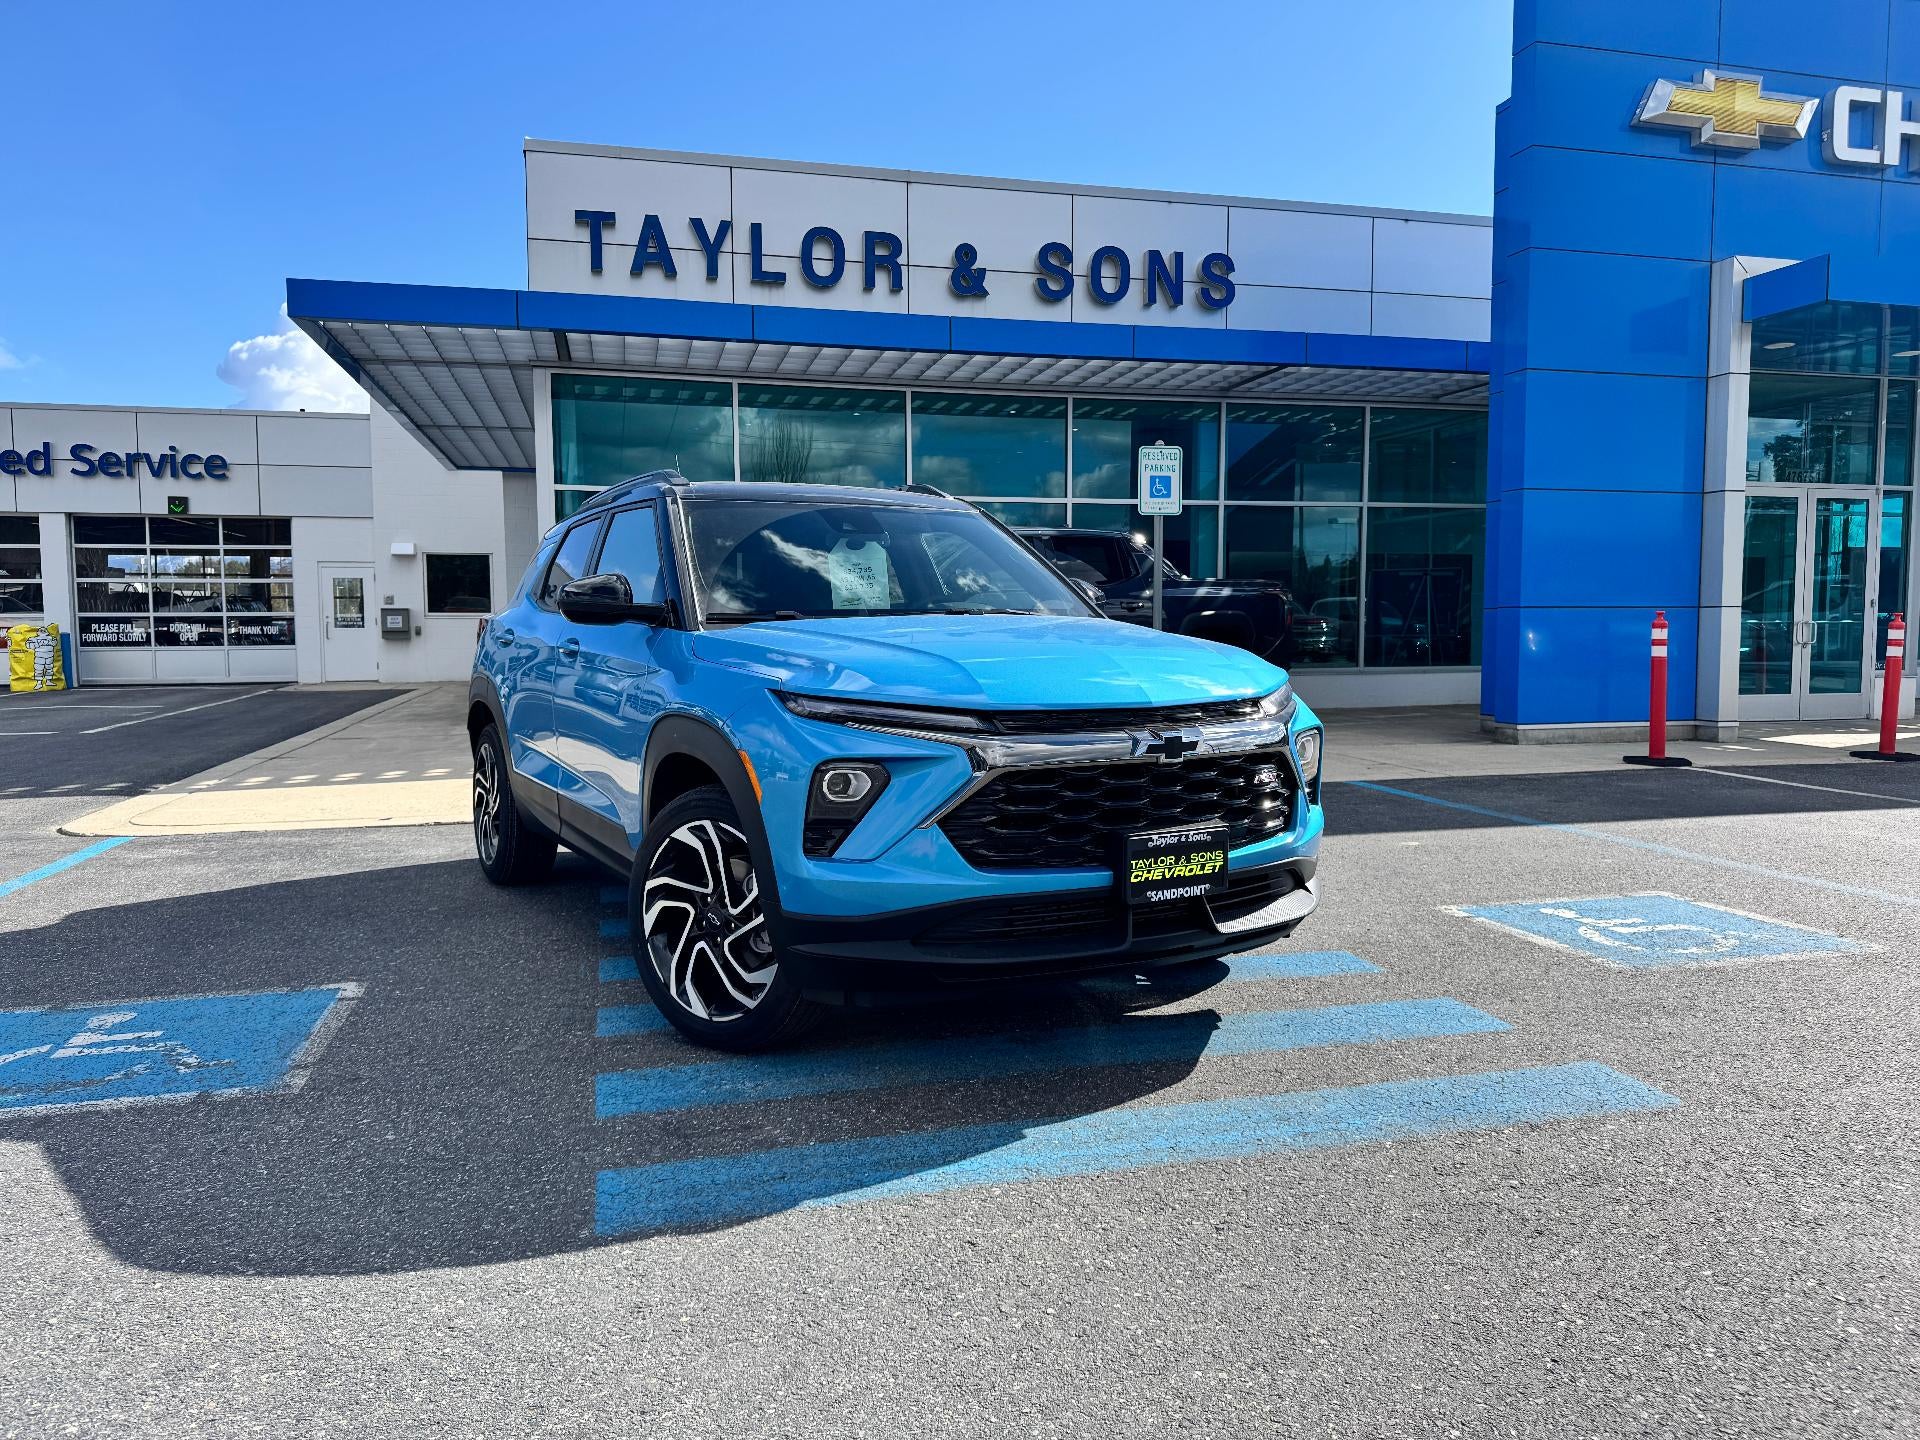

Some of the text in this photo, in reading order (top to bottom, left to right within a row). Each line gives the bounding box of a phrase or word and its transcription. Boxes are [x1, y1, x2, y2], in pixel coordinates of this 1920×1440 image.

[575, 210, 1237, 310] TAYLOR & SONS
[0, 441, 229, 480] ed Service
[1142, 451, 1178, 461] RESERVED
[1144, 463, 1176, 473] PARKING
[91, 623, 136, 633] PLEASE PULL
[169, 623, 208, 633] DOOR WILL
[239, 626, 279, 635] THANK YOU!
[82, 632, 147, 642] FORWARD SLOWLY
[180, 632, 199, 642] OPEN
[1151, 834, 1180, 848] Taylor
[1187, 832, 1208, 842] Sons
[1130, 850, 1224, 870] TAYLOR & SONS
[1130, 862, 1224, 883] CHEVROLET
[1150, 884, 1206, 902] SANDPOINT
